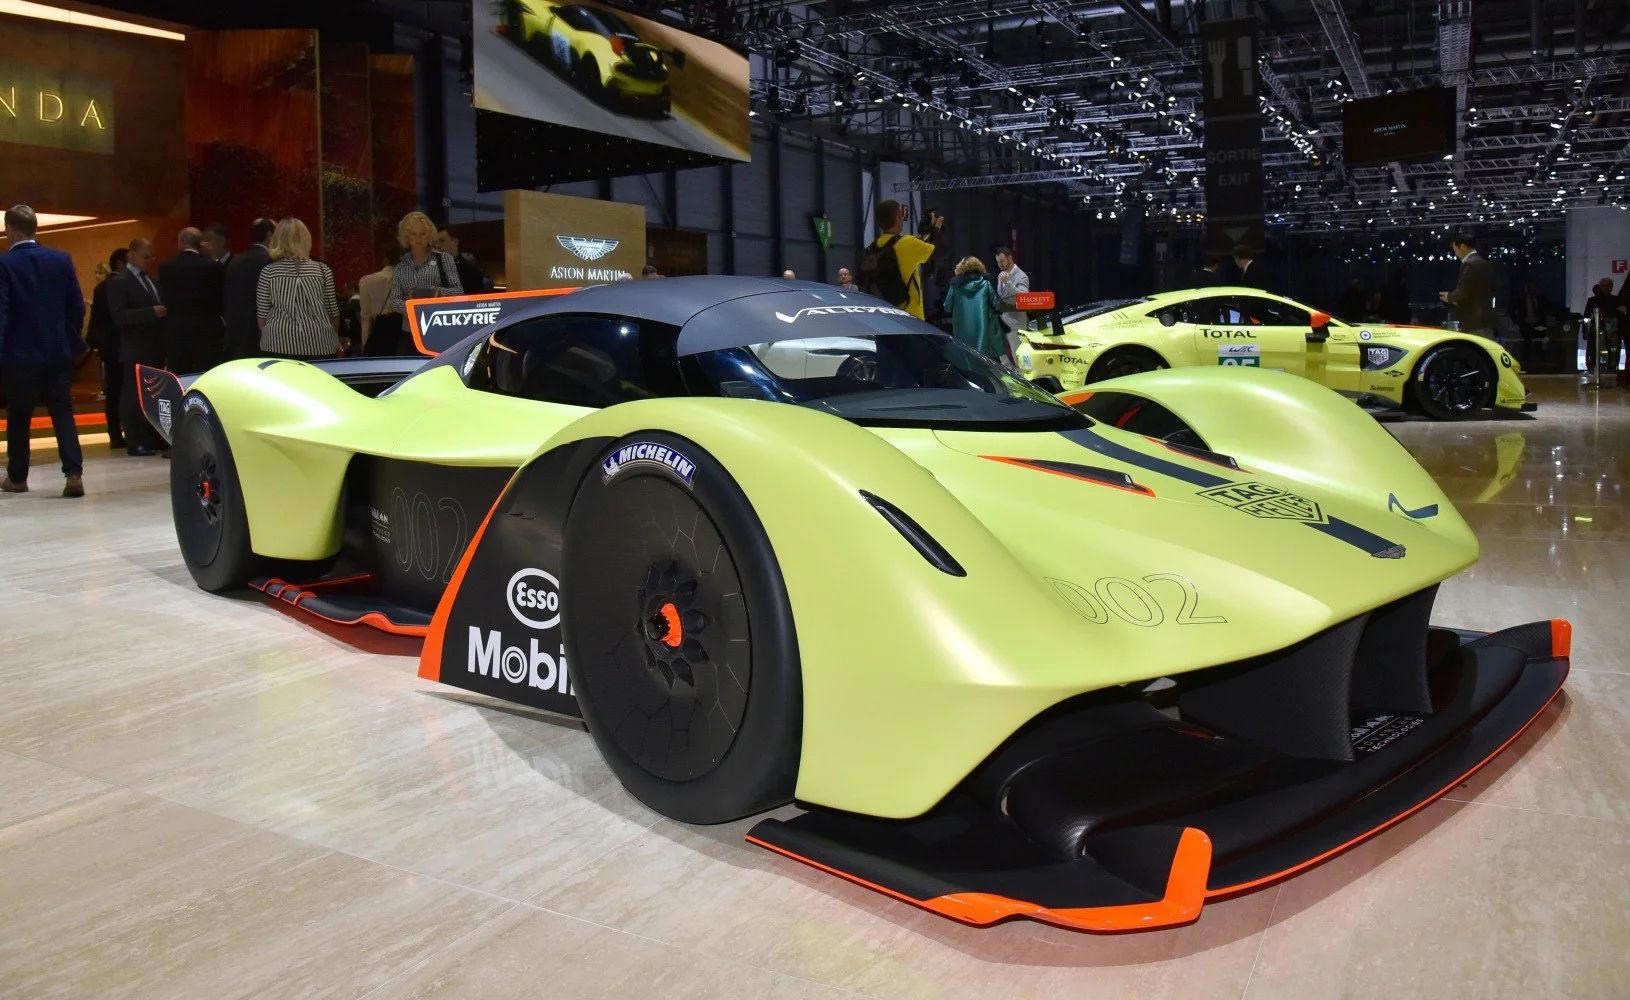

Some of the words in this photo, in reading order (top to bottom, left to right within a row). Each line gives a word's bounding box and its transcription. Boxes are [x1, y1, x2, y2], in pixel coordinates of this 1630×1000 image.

[1206, 148, 1261, 164] SORTIE
[1218, 172, 1251, 186] EXIT
[550, 266, 584, 280] ASTON
[587, 268, 626, 281] MARTIN
[1616, 260, 1625, 271] F
[420, 307, 502, 336] VALKYRIE
[618, 444, 693, 477] MICHELIN
[1208, 484, 1282, 503] TAG
[392, 486, 468, 584] 002
[516, 581, 559, 612] Esso
[1043, 573, 1228, 627] 002
[467, 625, 577, 697] Mobi
